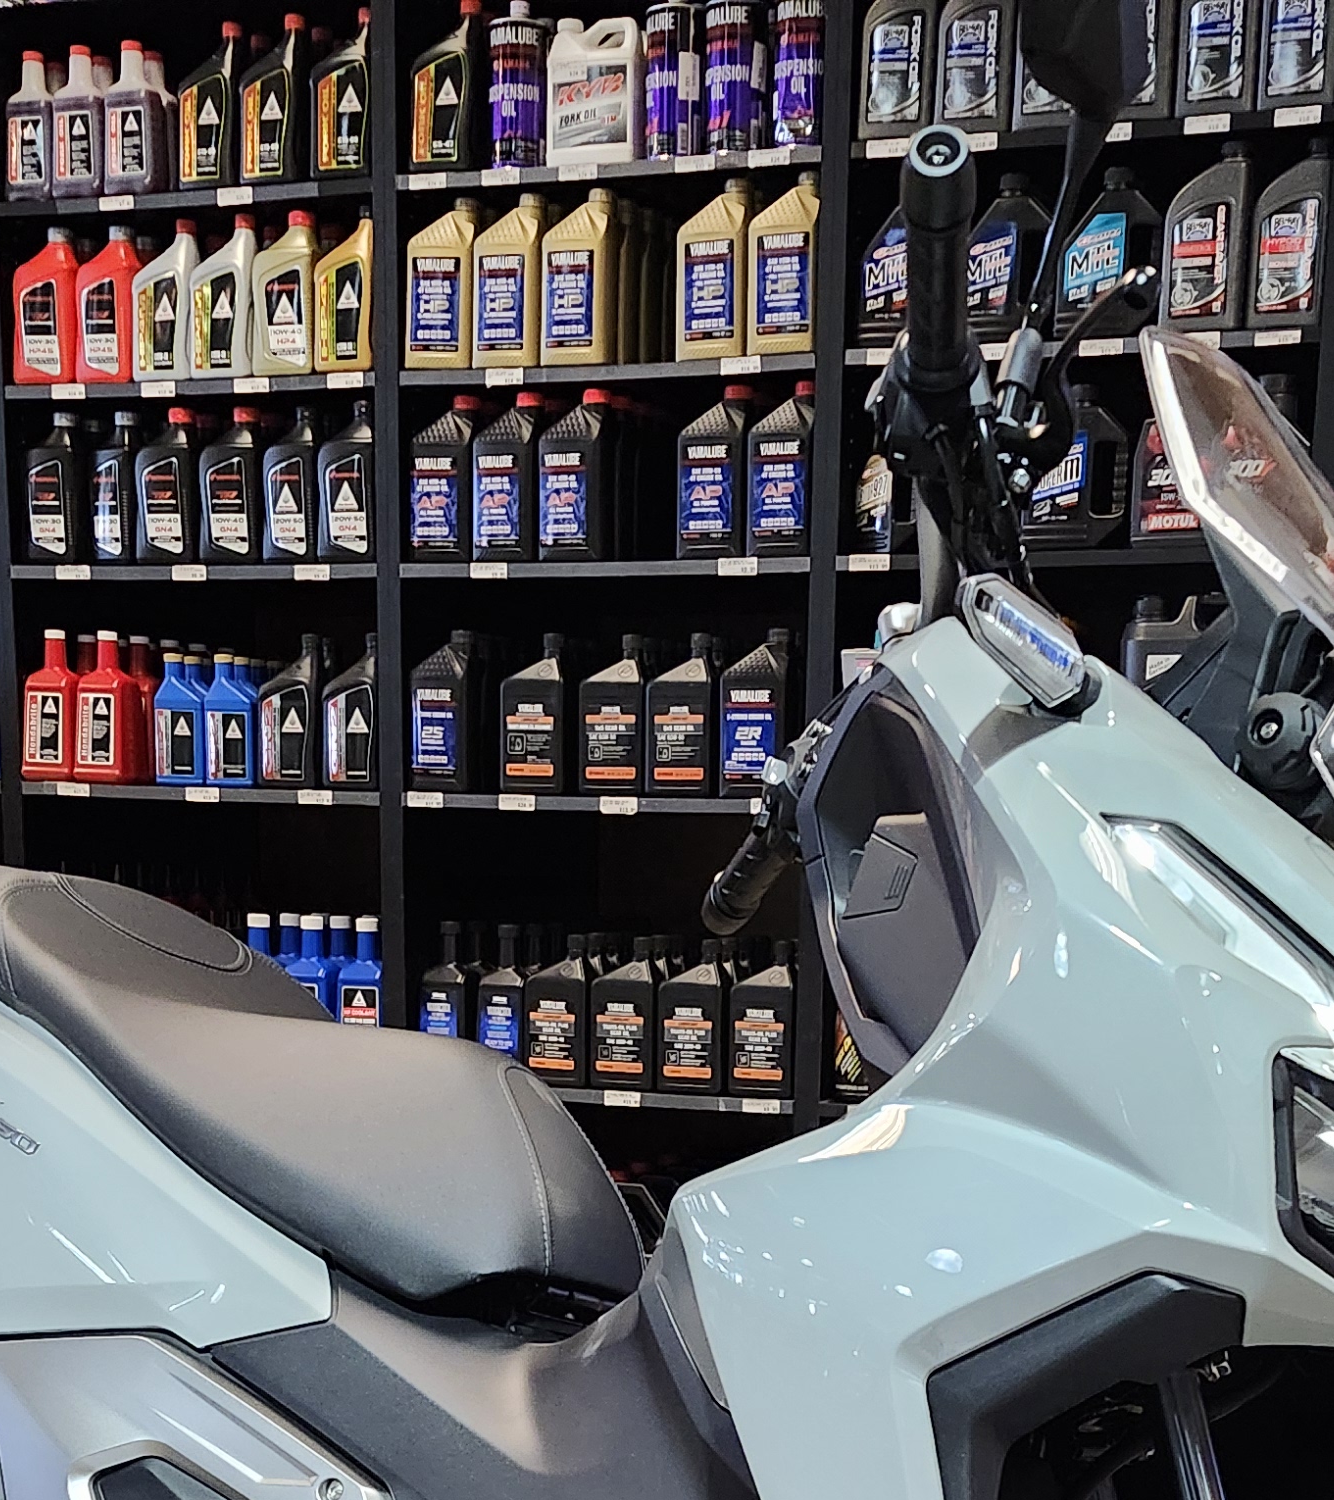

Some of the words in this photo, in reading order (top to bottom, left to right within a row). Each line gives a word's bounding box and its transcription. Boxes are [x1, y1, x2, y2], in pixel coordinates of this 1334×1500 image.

[910, 15, 923, 62] FORK
[986, 9, 999, 57] FORK
[558, 72, 625, 107] KYB
[710, 82, 726, 101] OIL
[790, 76, 807, 95] OIL
[501, 100, 517, 118] OIL
[559, 111, 581, 127] FORK
[583, 107, 597, 121] OIL
[689, 239, 731, 258] YAMALUBE
[762, 232, 806, 251] YAMALUBE
[417, 257, 456, 273] YAMALUBE
[482, 255, 522, 271] YAMALUBE
[550, 251, 591, 267] YAMALUBE
[554, 294, 584, 308] HP
[692, 284, 725, 303] HP
[419, 299, 450, 313] HP
[486, 297, 515, 312] HP
[269, 328, 302, 336] 10W-40
[276, 337, 297, 346] HP4
[687, 444, 729, 460] YAMALUBE
[759, 438, 801, 457] YAMALUBE
[414, 456, 454, 471] YAMALUBE
[477, 454, 515, 470] YAMALUBE
[544, 452, 582, 468] YAMALUBE
[689, 484, 724, 501] AP
[761, 481, 796, 499] AP
[417, 495, 448, 509] AP
[480, 493, 510, 509] AP
[546, 491, 577, 508] AP
[34, 517, 62, 525] 10W-30
[216, 516, 245, 524] 10W-40
[338, 524, 358, 532] GN4
[1148, 513, 1199, 530] MOTUL
[154, 526, 174, 534] GN4
[279, 526, 297, 534] GN4
[417, 688, 452, 702] YAMALUBE
[729, 688, 772, 703] YAMALUBE
